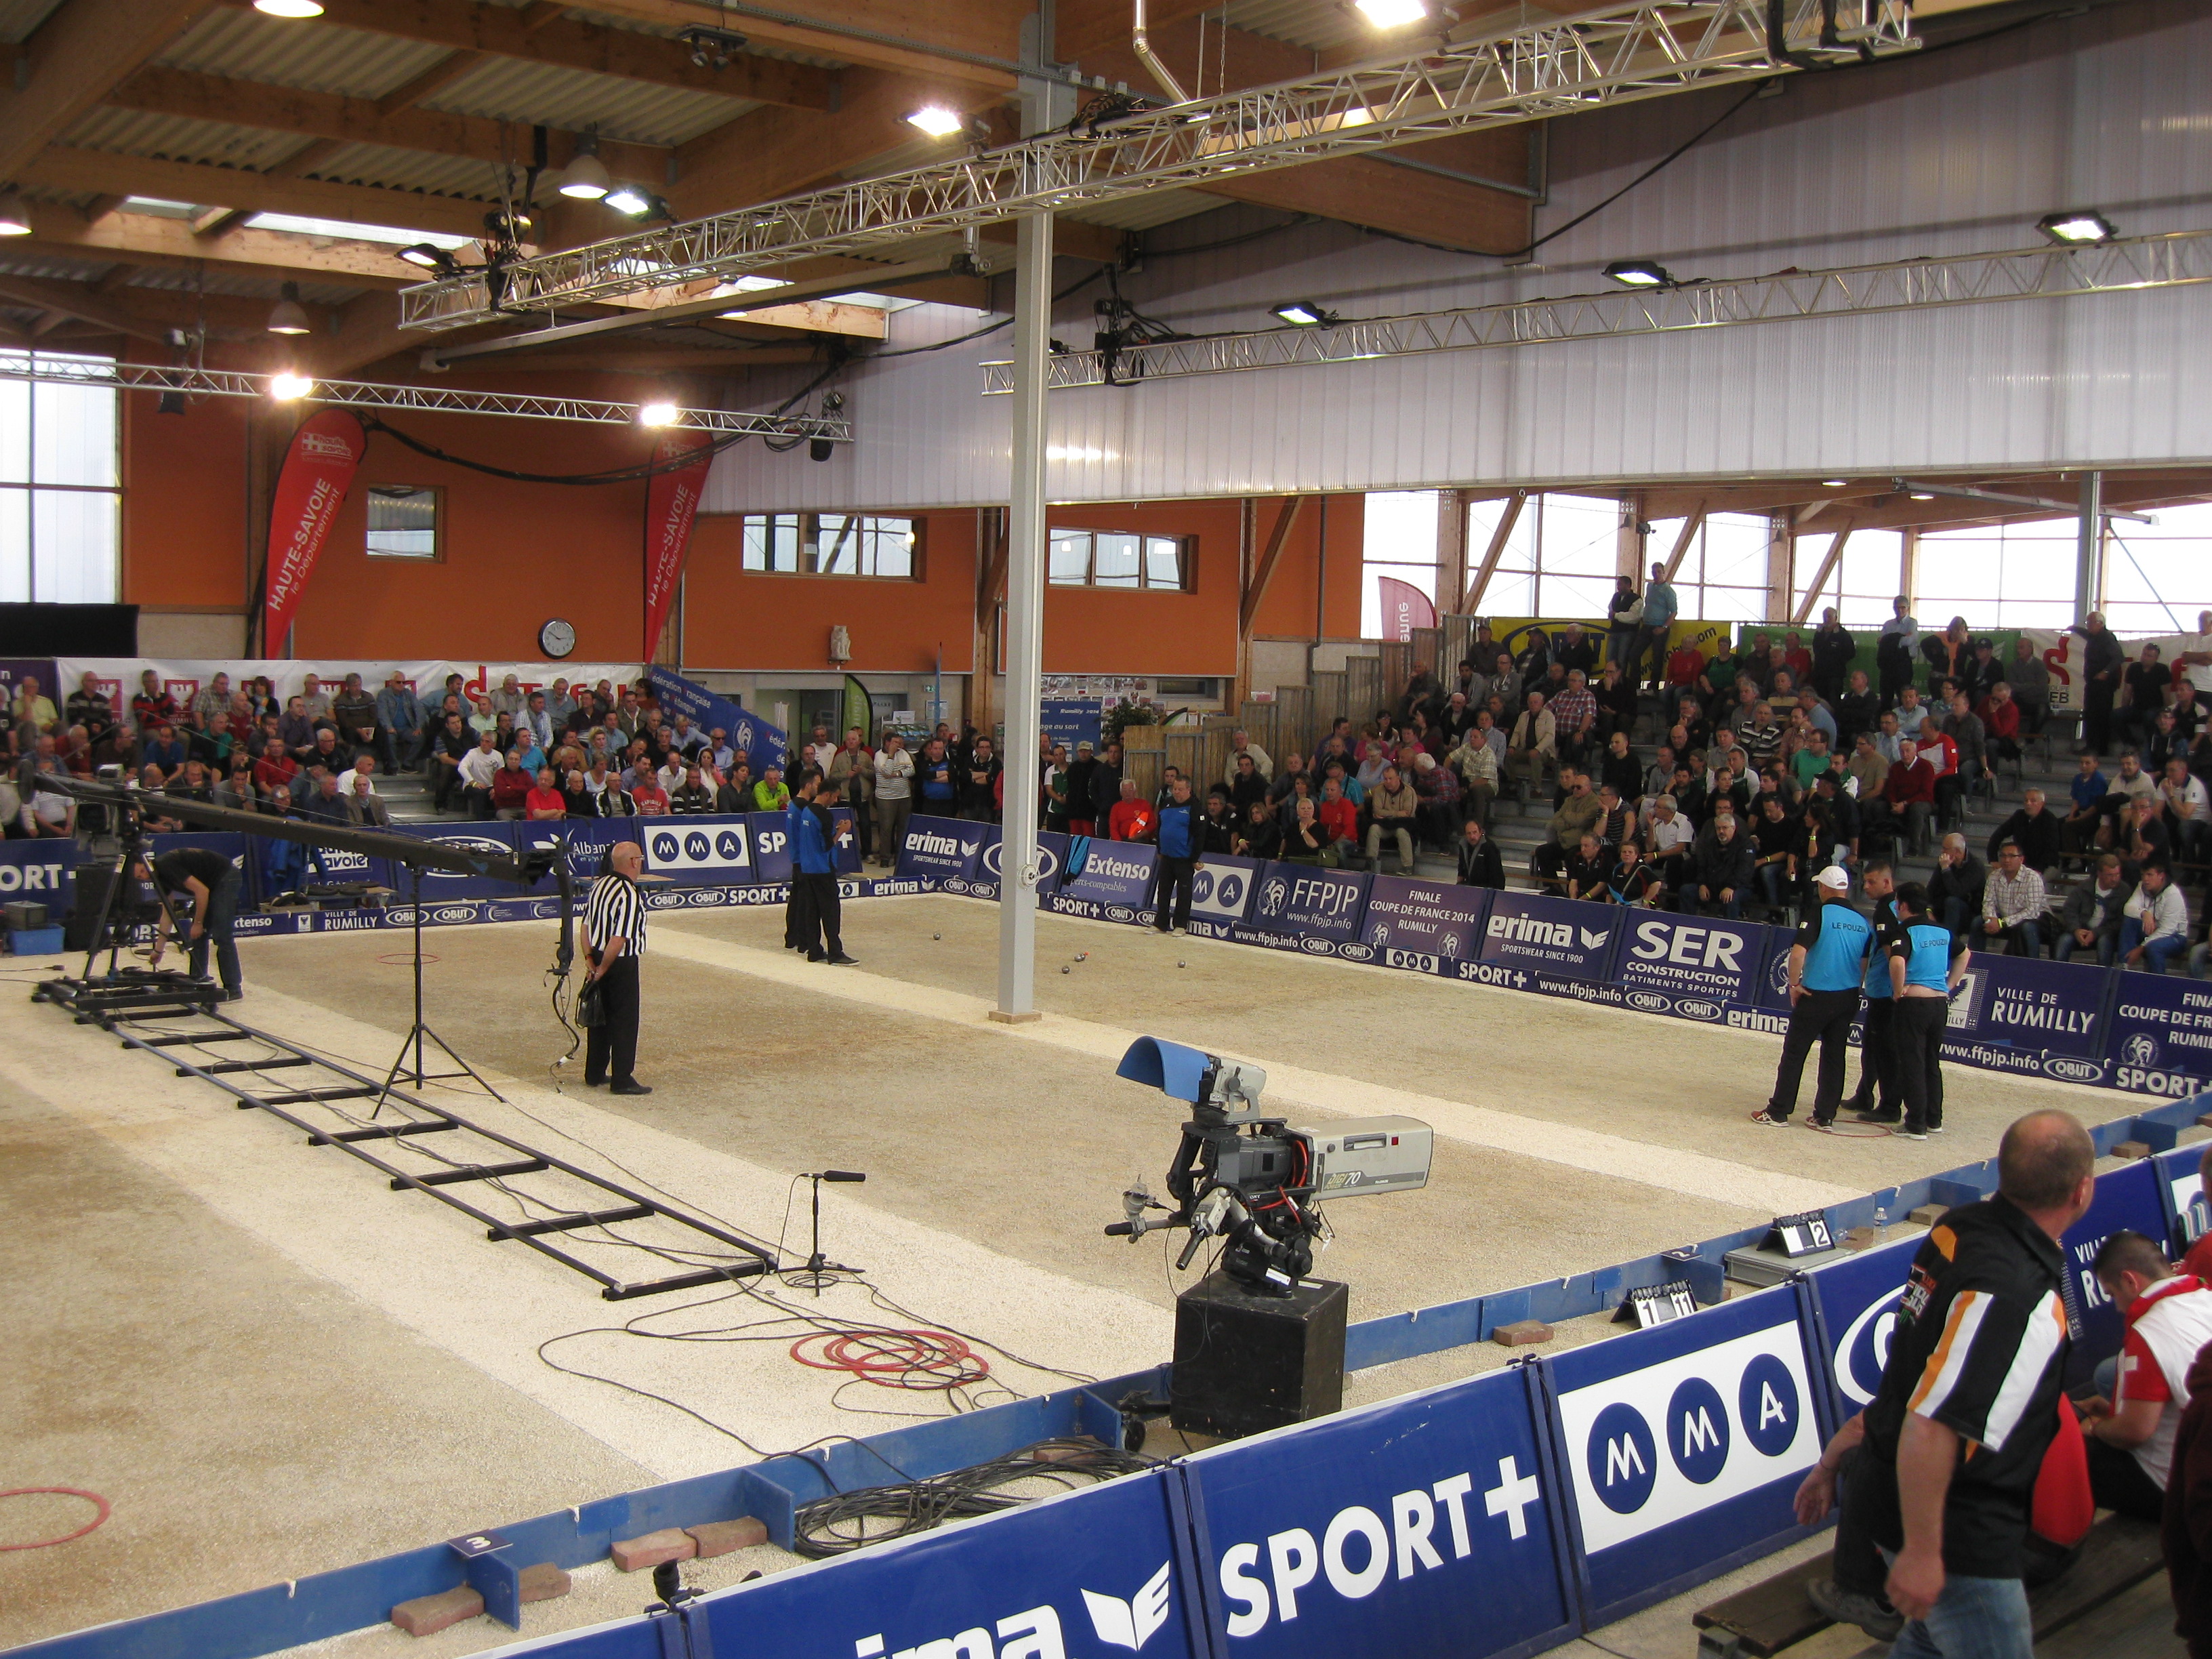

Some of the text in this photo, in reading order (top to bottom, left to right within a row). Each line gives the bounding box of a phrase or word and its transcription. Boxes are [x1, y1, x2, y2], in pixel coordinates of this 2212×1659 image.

[269, 478, 331, 611] HAUTE-SAVOIE
[649, 483, 689, 607] HAUTE-SAVOIE
[658, 838, 737, 855] MMA
[905, 830, 958, 857] erima
[1085, 852, 1151, 881] Extenso
[874, 879, 918, 896] erima
[949, 880, 964, 891] OBUT
[976, 885, 991, 895] OBUT
[655, 895, 678, 905] OBUT
[695, 891, 718, 903] OBUT
[729, 886, 791, 904] SPORT+
[1291, 878, 1359, 916] FFPJP
[1409, 889, 1441, 904] FINALE
[441, 908, 468, 920] OBUT
[1052, 896, 1101, 918] SPORT+
[1110, 907, 1129, 919] OBUT
[1369, 900, 1475, 924] COUPE DE FRANCE 2014
[325, 916, 378, 930] RUMILLY
[1287, 912, 1353, 930] www.ffpjp.info
[1397, 919, 1439, 935] RUMILLY
[1487, 912, 1574, 948] erima
[1832, 922, 1842, 930] LE
[1234, 928, 1298, 948] www.ffpjp.info
[1308, 939, 1329, 952] OBUT
[1630, 920, 1742, 972] SER
[1920, 940, 1928, 949] LE
[1345, 945, 1367, 958] OBUT
[1500, 943, 1584, 964] SPORTSWEAR SINCE 1900
[1395, 955, 1429, 967] MMA
[1458, 961, 1528, 989] SPORT+
[1626, 961, 1740, 987] CONSTRUCTION
[1539, 979, 1622, 1002] www.ffpjp.info
[1622, 973, 1738, 998] BATIMENTS SPORTIFS
[1634, 993, 1661, 1008] OBUT
[1997, 987, 2058, 1005] VILLE DE
[1683, 1000, 1713, 1017] OBUT
[1991, 1000, 2095, 1034] RUMILLY
[2118, 1004, 2170, 1023] COUPE
[2171, 1010, 2192, 1025] DE
[1727, 1008, 1790, 1034] erima
[2055, 1060, 2091, 1078] OBUT
[1345, 1171, 1361, 1185] 70
[1813, 1224, 1829, 1245] 2
[1642, 1294, 1694, 1325] 1 11
[1605, 1379, 1788, 1488] MMA
[466, 1536, 492, 1549] 3
[1220, 1454, 1540, 1637] SPORT+
